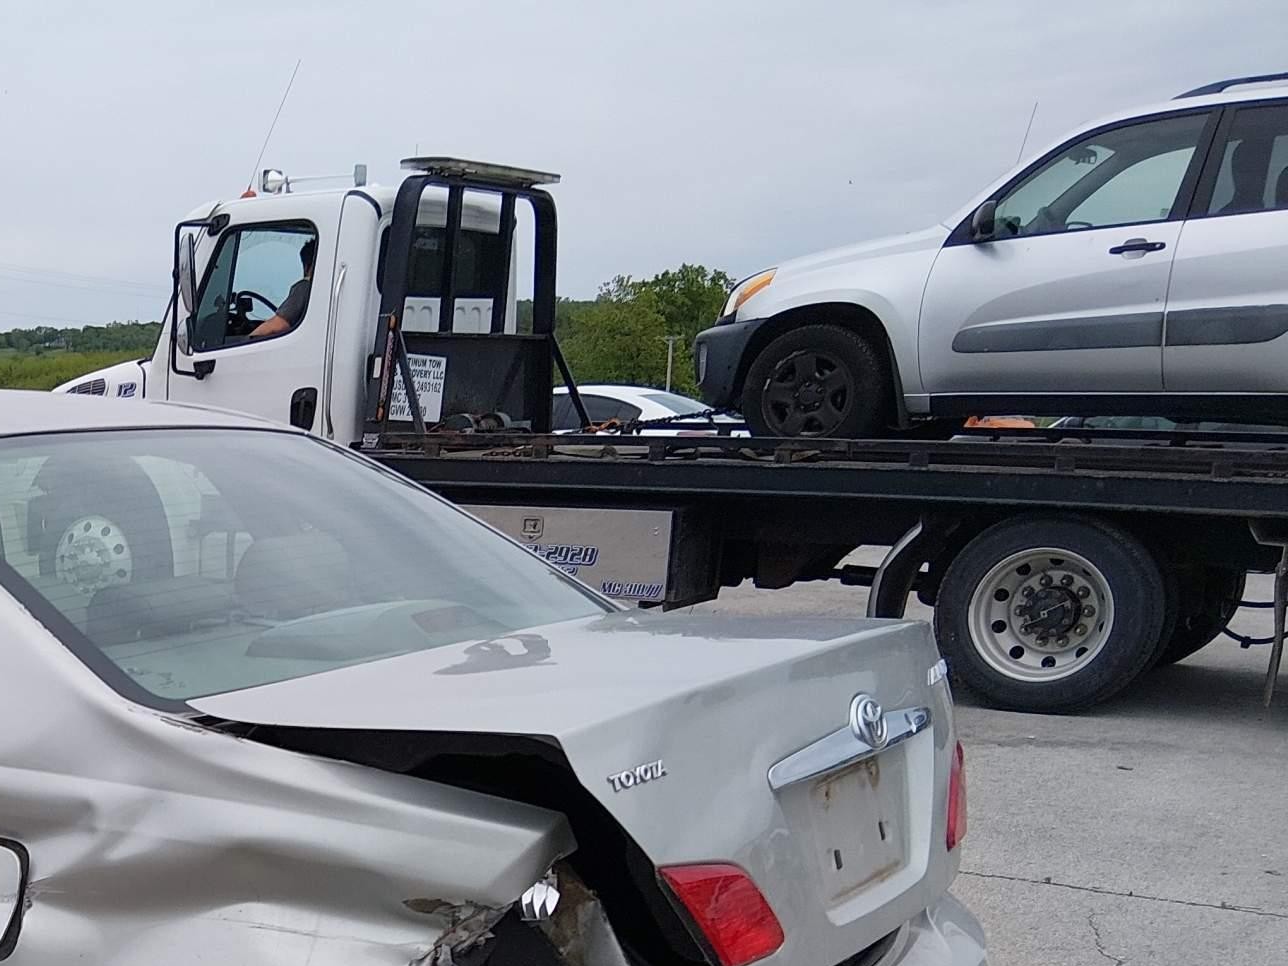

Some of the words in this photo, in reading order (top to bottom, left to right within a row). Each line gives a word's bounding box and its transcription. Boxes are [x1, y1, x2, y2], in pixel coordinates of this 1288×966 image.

[429, 359, 442, 369] TOW
[432, 370, 444, 380] LLC
[117, 382, 137, 398] 12
[607, 760, 667, 792] TOYOTA
